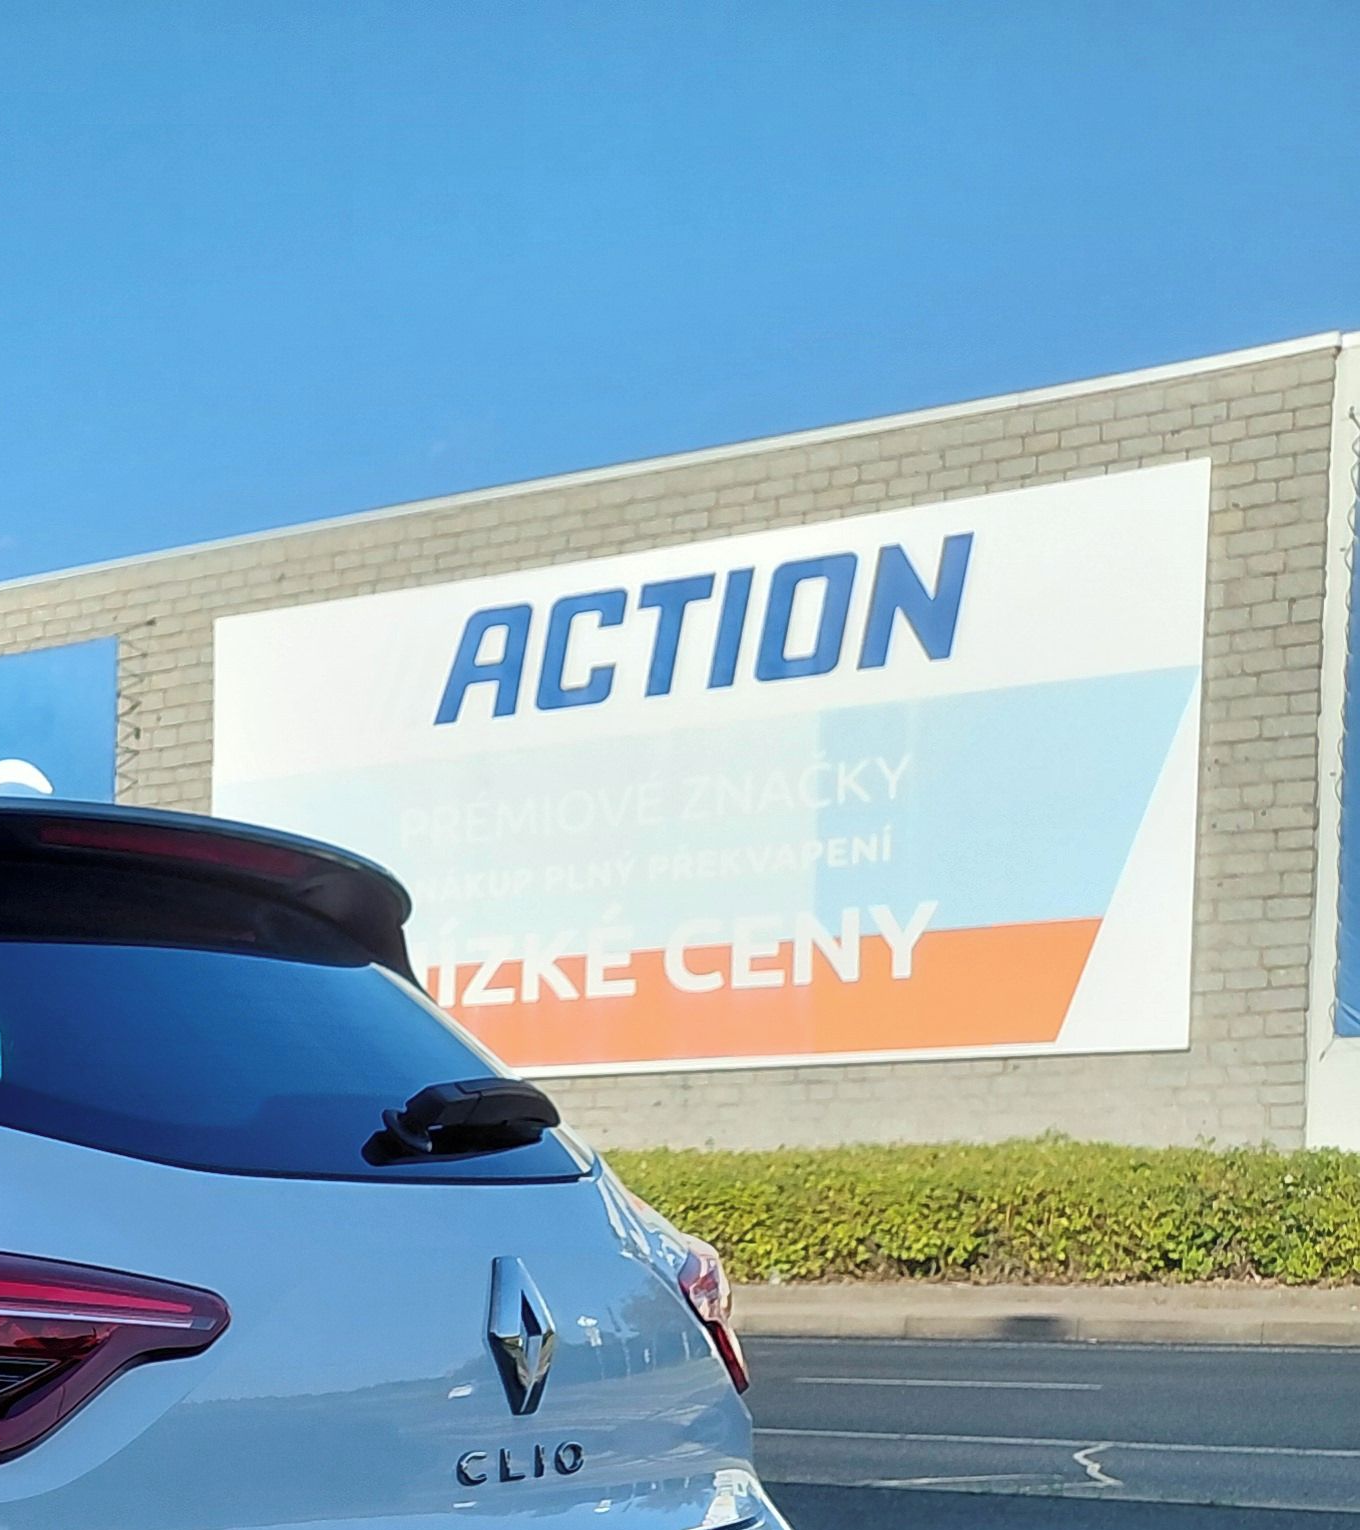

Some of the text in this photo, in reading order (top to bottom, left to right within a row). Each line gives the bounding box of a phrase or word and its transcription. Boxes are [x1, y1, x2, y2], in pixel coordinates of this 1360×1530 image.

[434, 531, 974, 726] ACTION
[681, 751, 911, 819] ZNAČKY
[545, 850, 636, 892] PLNÝ
[648, 824, 893, 881] PŘEKVAPENÍ
[662, 901, 939, 994] CENY
[456, 1440, 584, 1487] CLIO
